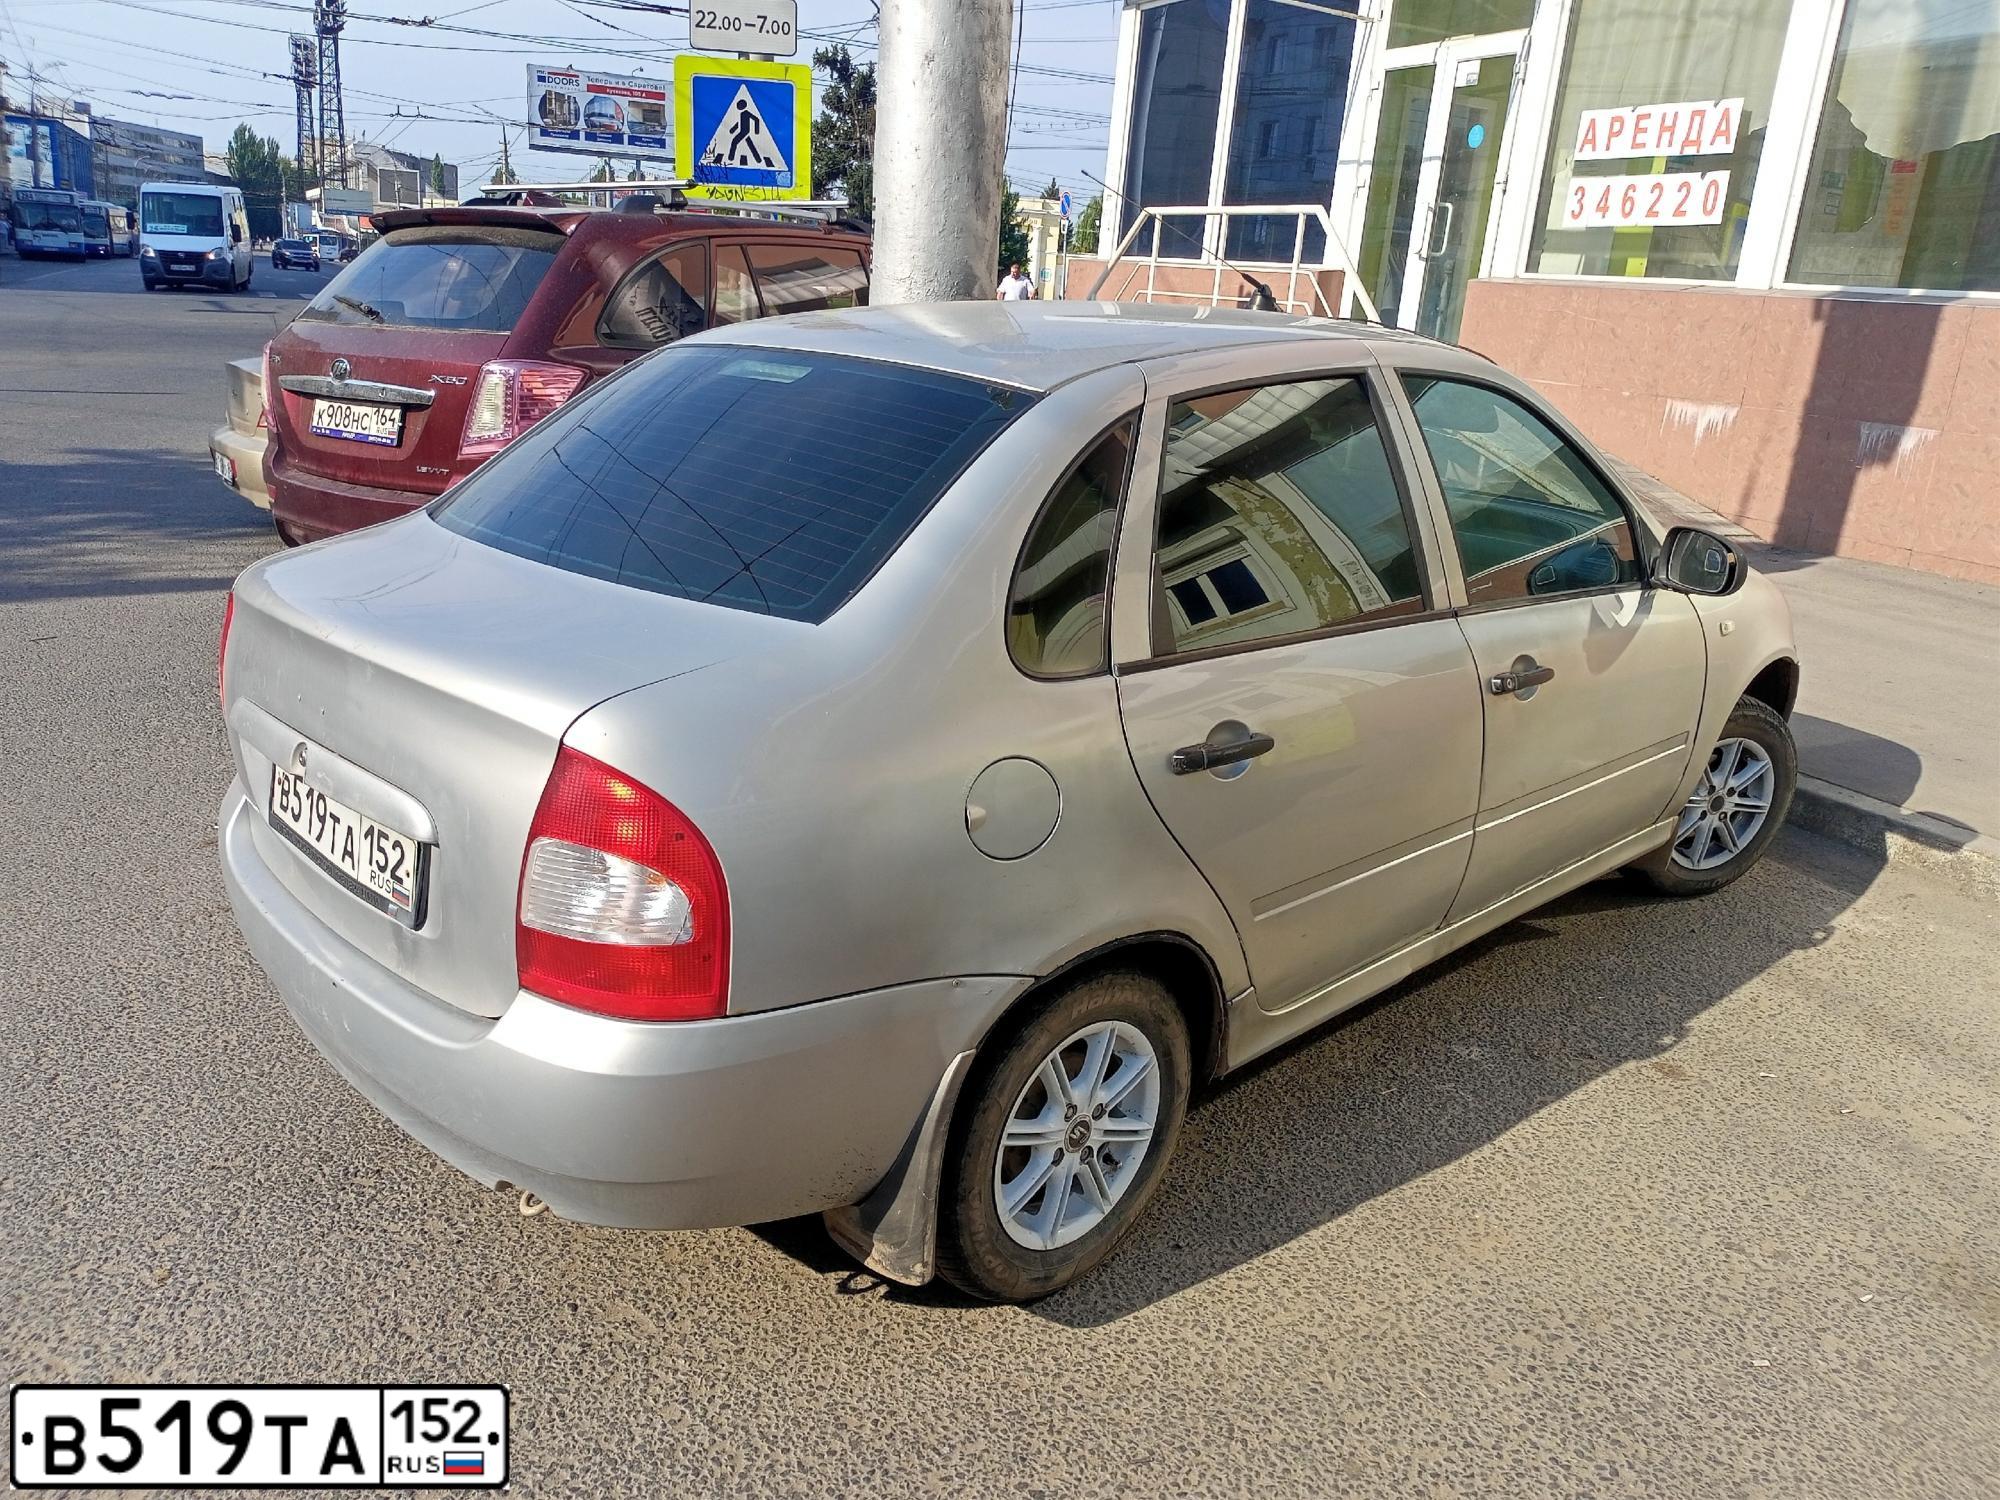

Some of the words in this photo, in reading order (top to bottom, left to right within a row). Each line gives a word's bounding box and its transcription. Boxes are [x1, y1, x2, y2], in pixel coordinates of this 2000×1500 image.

[547, 76, 580, 88] DOORS
[586, 75, 613, 86] Теперь
[627, 80, 666, 91] Саратове!
[1578, 107, 1731, 155] АРЕНДА
[1571, 179, 1720, 220] 346220
[316, 404, 370, 431] К908НС
[373, 407, 396, 428] 164
[376, 426, 388, 435] RUS
[279, 773, 356, 871] В519ТА
[363, 824, 405, 885] 152
[369, 869, 392, 894] RUS
